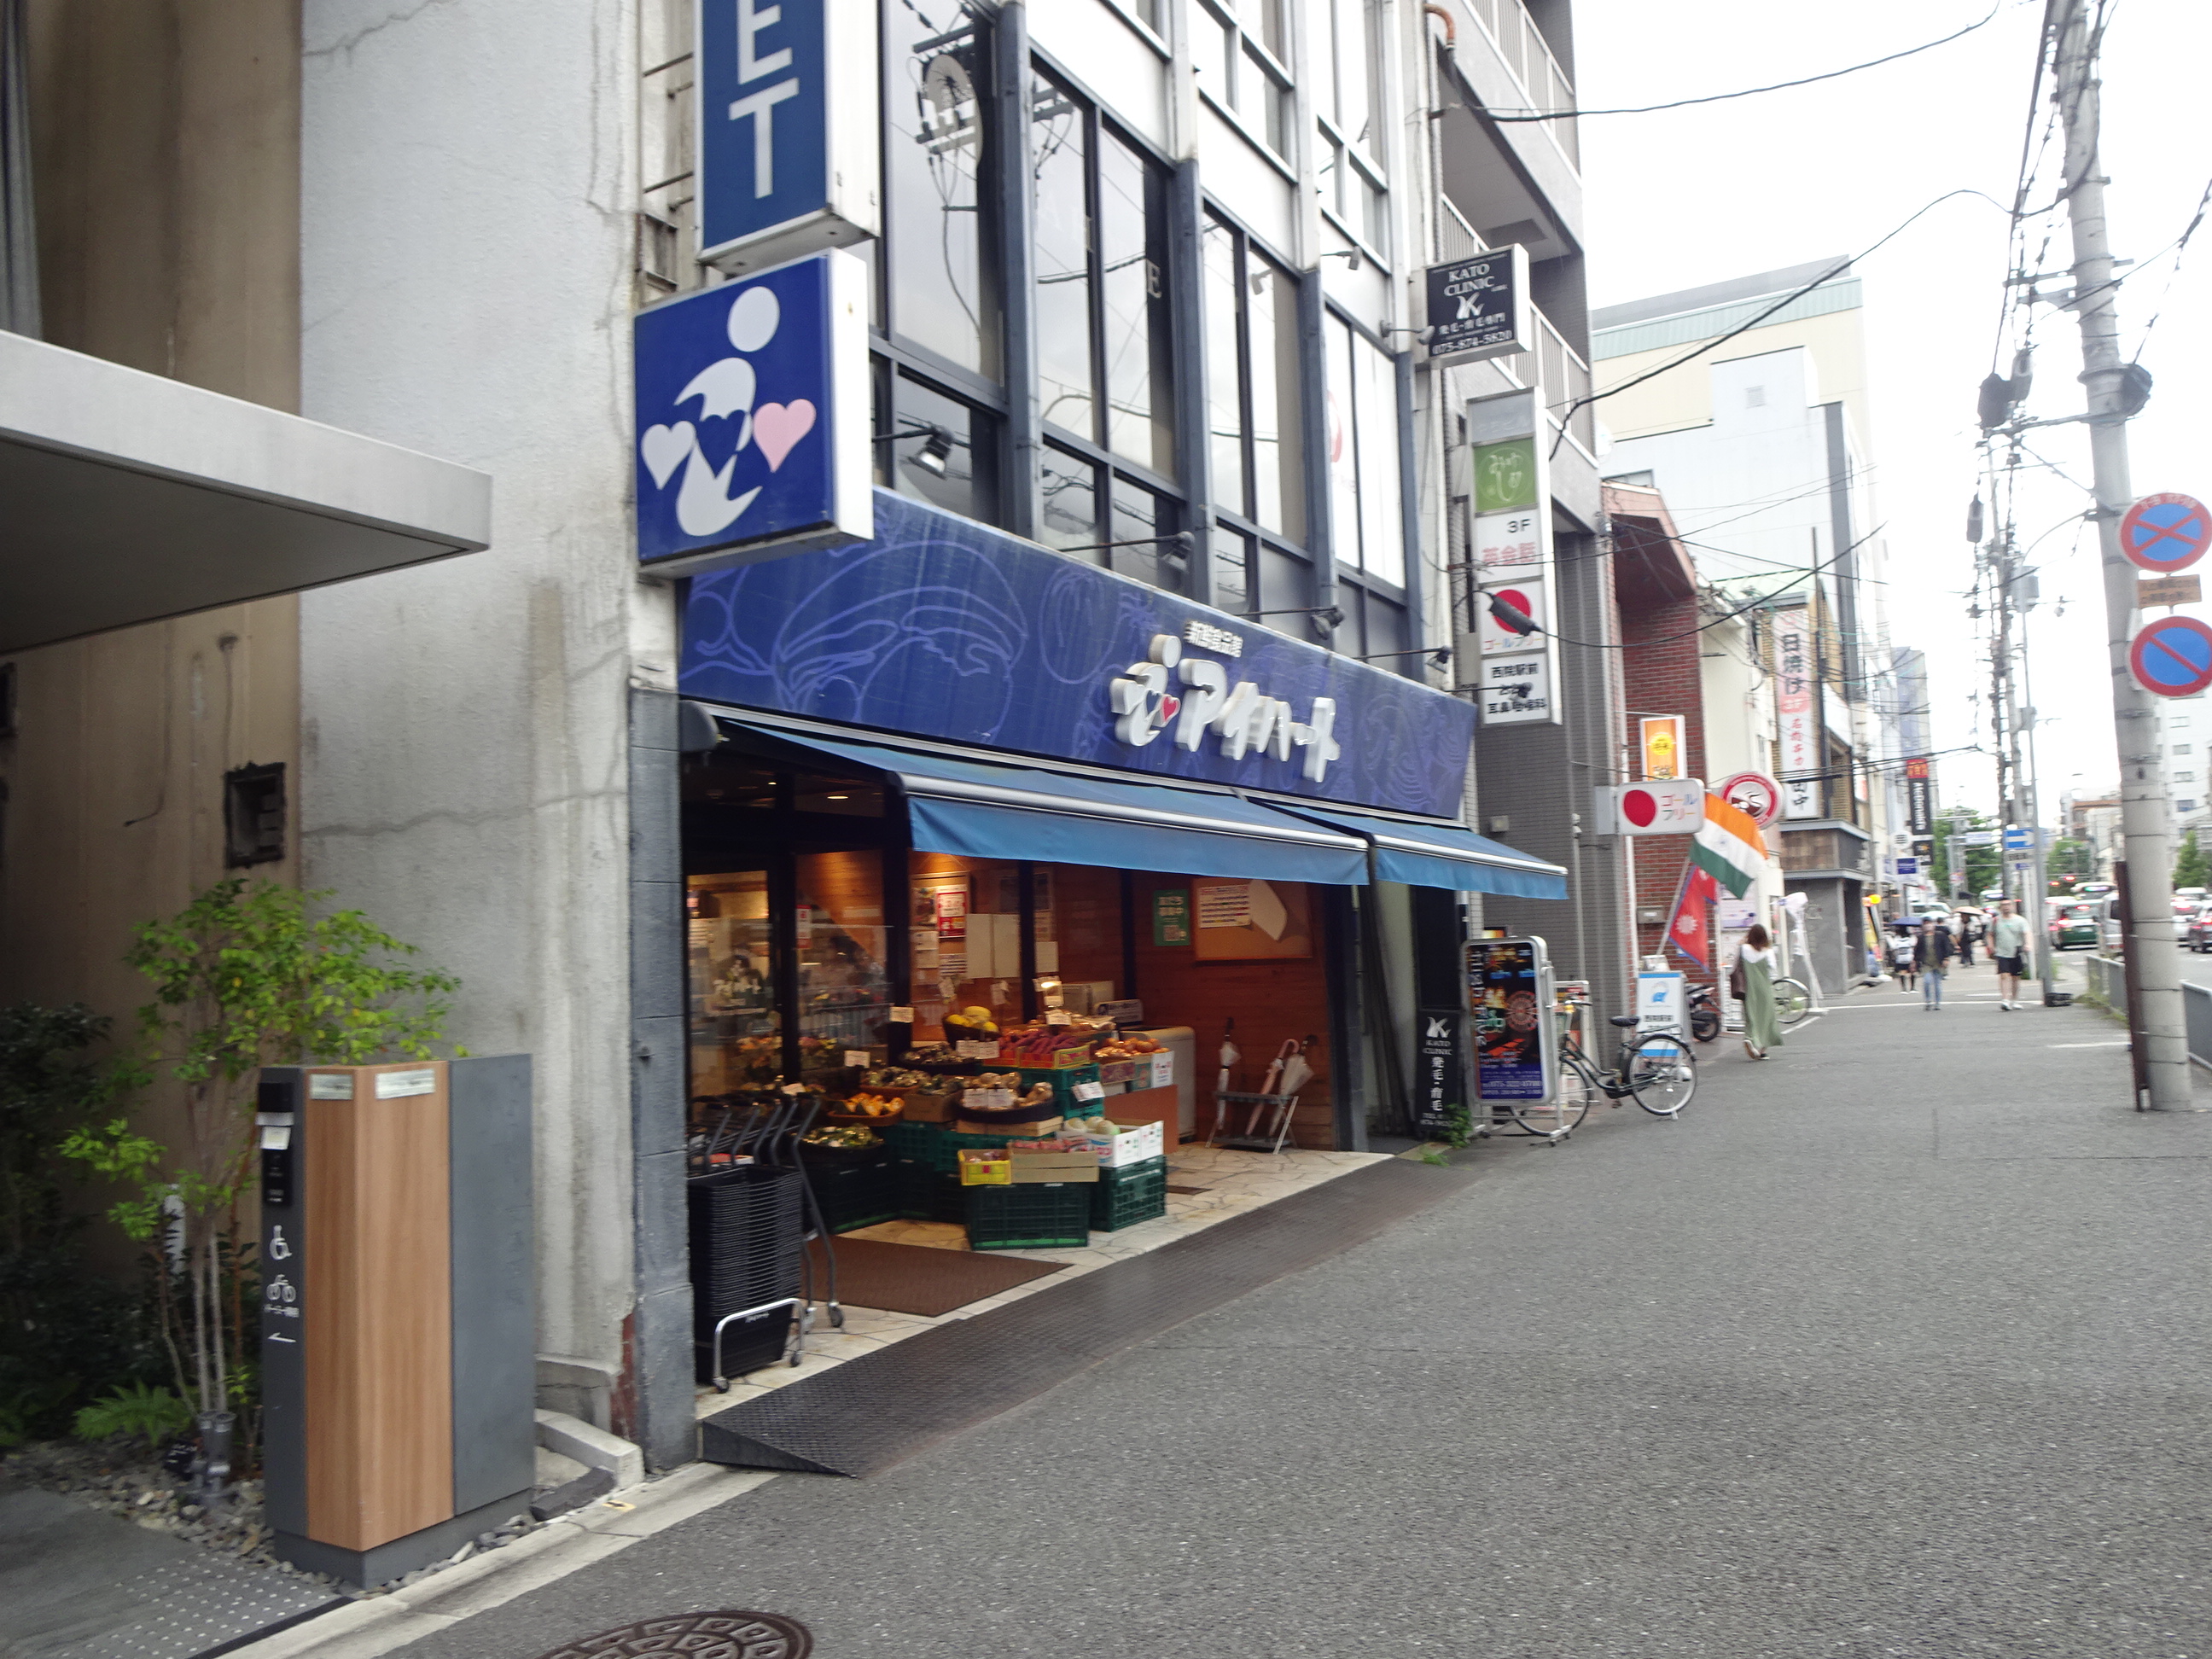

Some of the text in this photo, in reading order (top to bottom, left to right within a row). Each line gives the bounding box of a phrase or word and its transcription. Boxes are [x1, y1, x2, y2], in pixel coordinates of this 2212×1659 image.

[1448, 264, 1490, 282] KATO
[1443, 276, 1495, 297] CLINIC
[1507, 518, 1531, 533] 3F
[1482, 542, 1536, 566] 英会話
[1491, 663, 1540, 678] 西院駅前
[1661, 794, 1698, 806] ゴール
[1662, 809, 1696, 821] フリー
